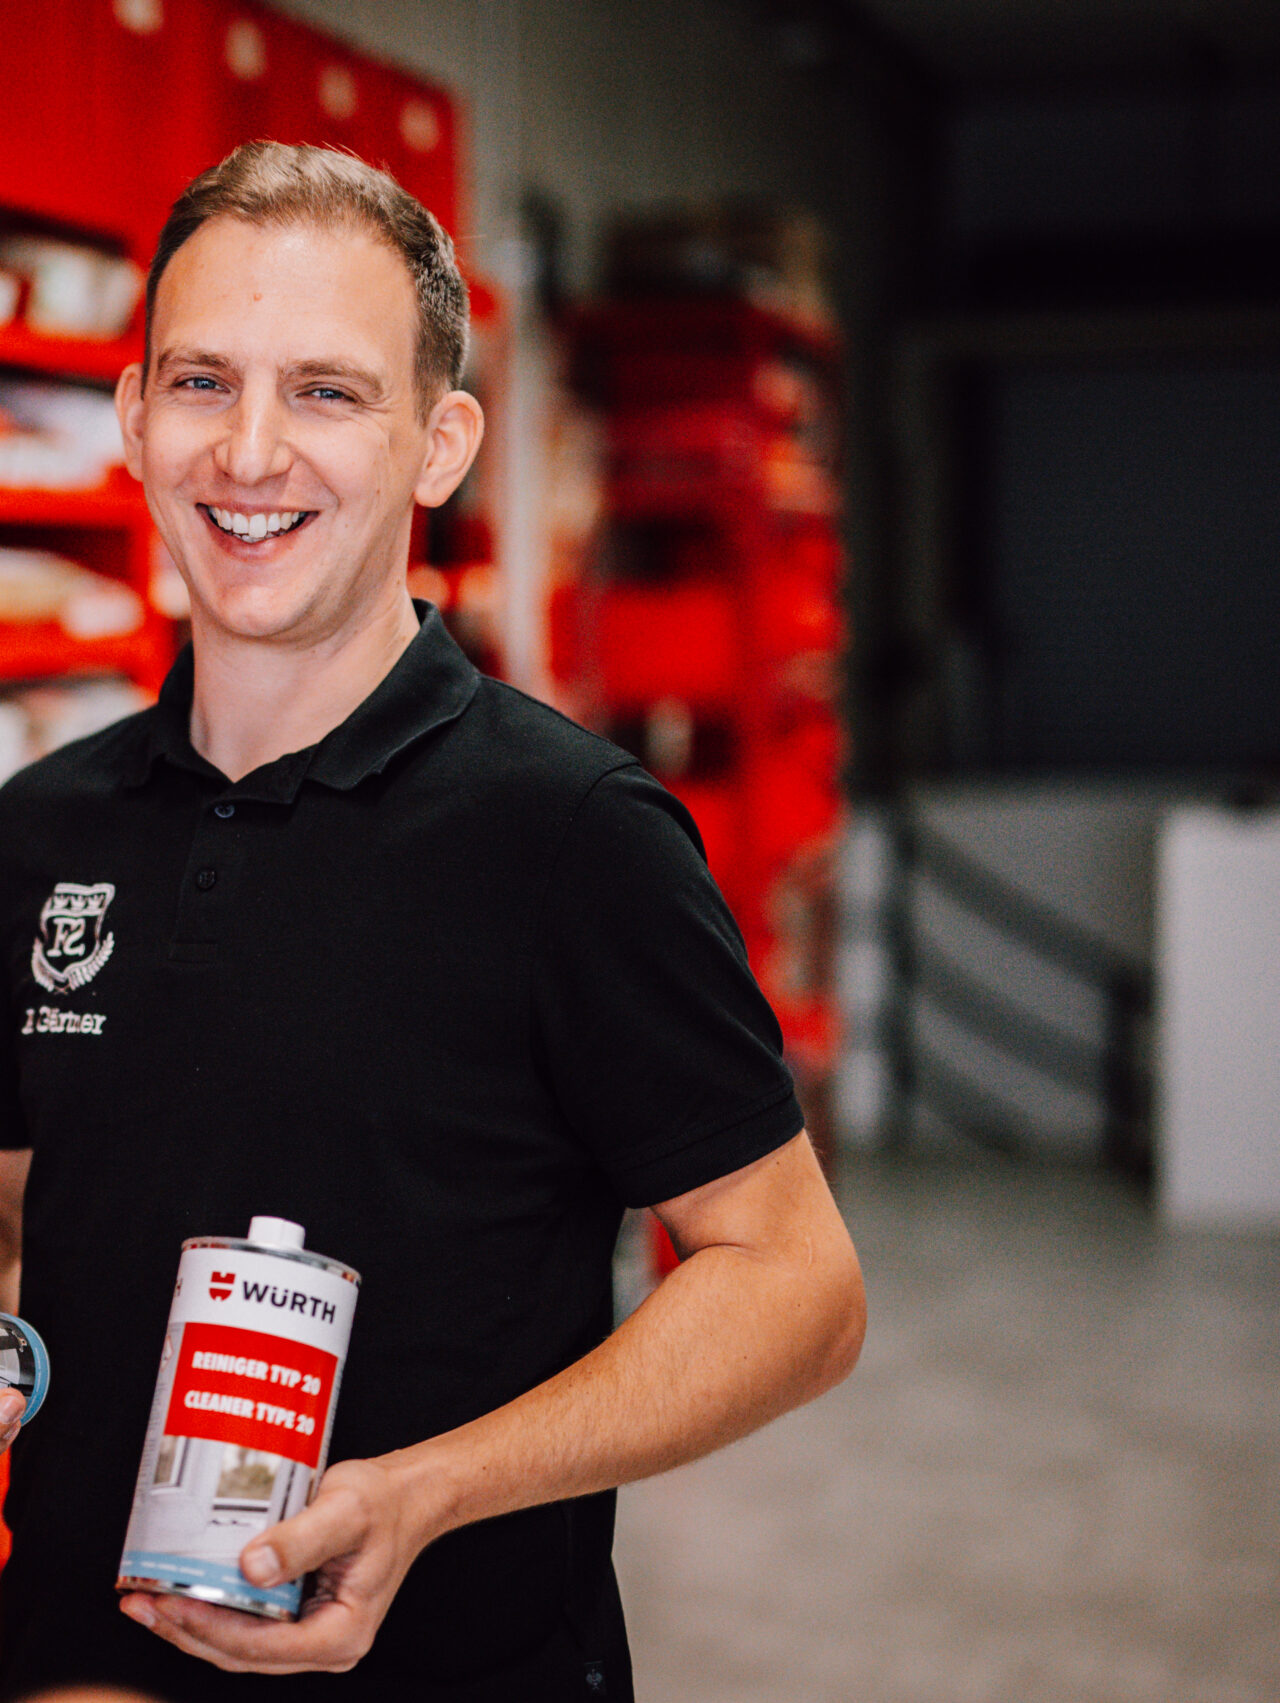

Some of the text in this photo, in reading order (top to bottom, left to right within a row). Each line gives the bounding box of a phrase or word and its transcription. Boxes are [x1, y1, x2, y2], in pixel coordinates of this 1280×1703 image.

[243, 1280, 337, 1324] WÜRTH
[192, 1351, 322, 1396] REINIGER TYP 20
[184, 1390, 316, 1436] CLEANER TYPE 20
